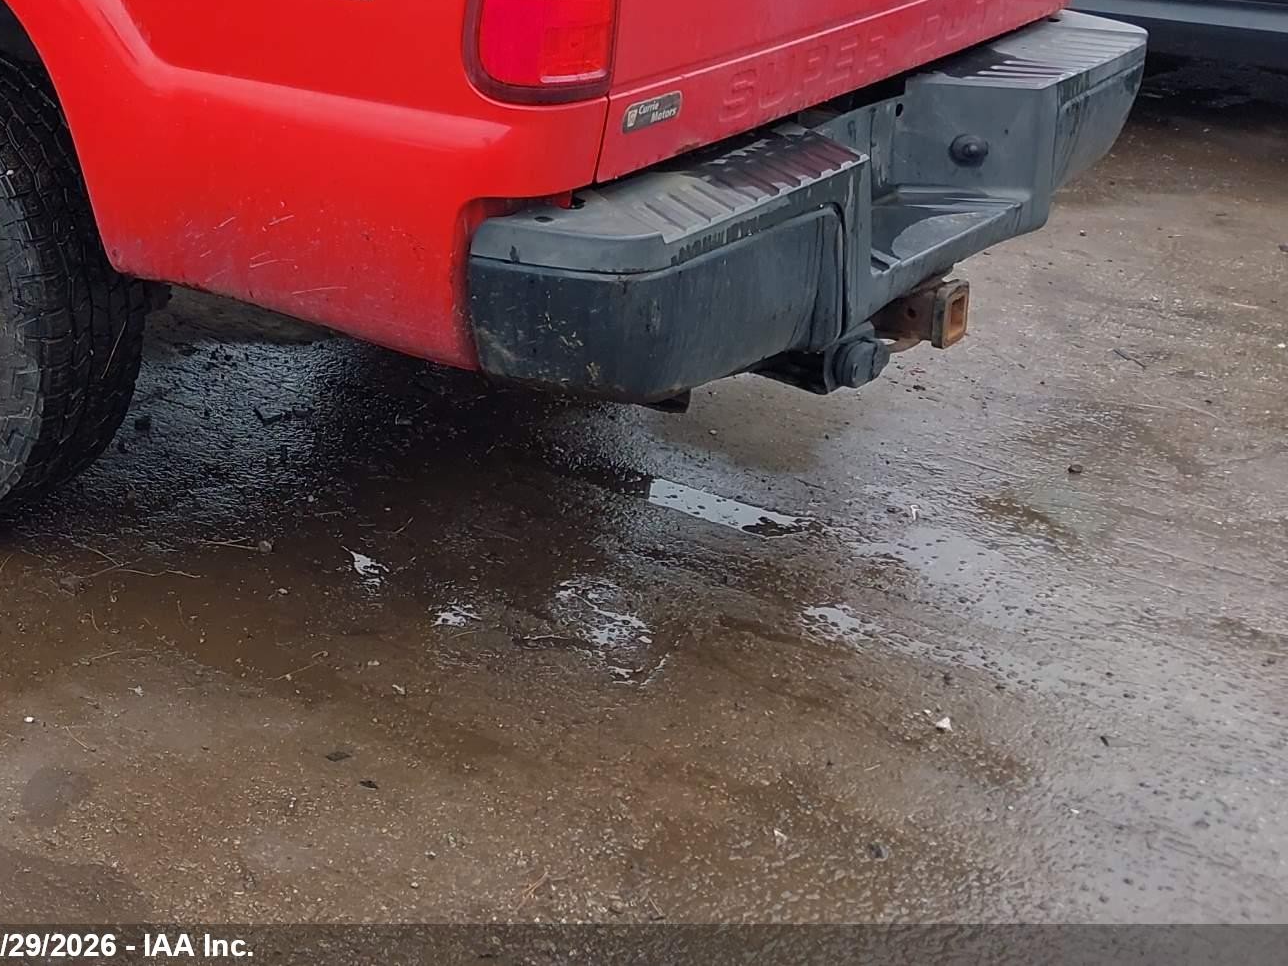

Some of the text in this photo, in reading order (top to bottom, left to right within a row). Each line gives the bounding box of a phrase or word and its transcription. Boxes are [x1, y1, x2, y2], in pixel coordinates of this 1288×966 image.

[718, 32, 888, 123] SUPER
[638, 101, 660, 115] Currie
[650, 107, 678, 123] Motors
